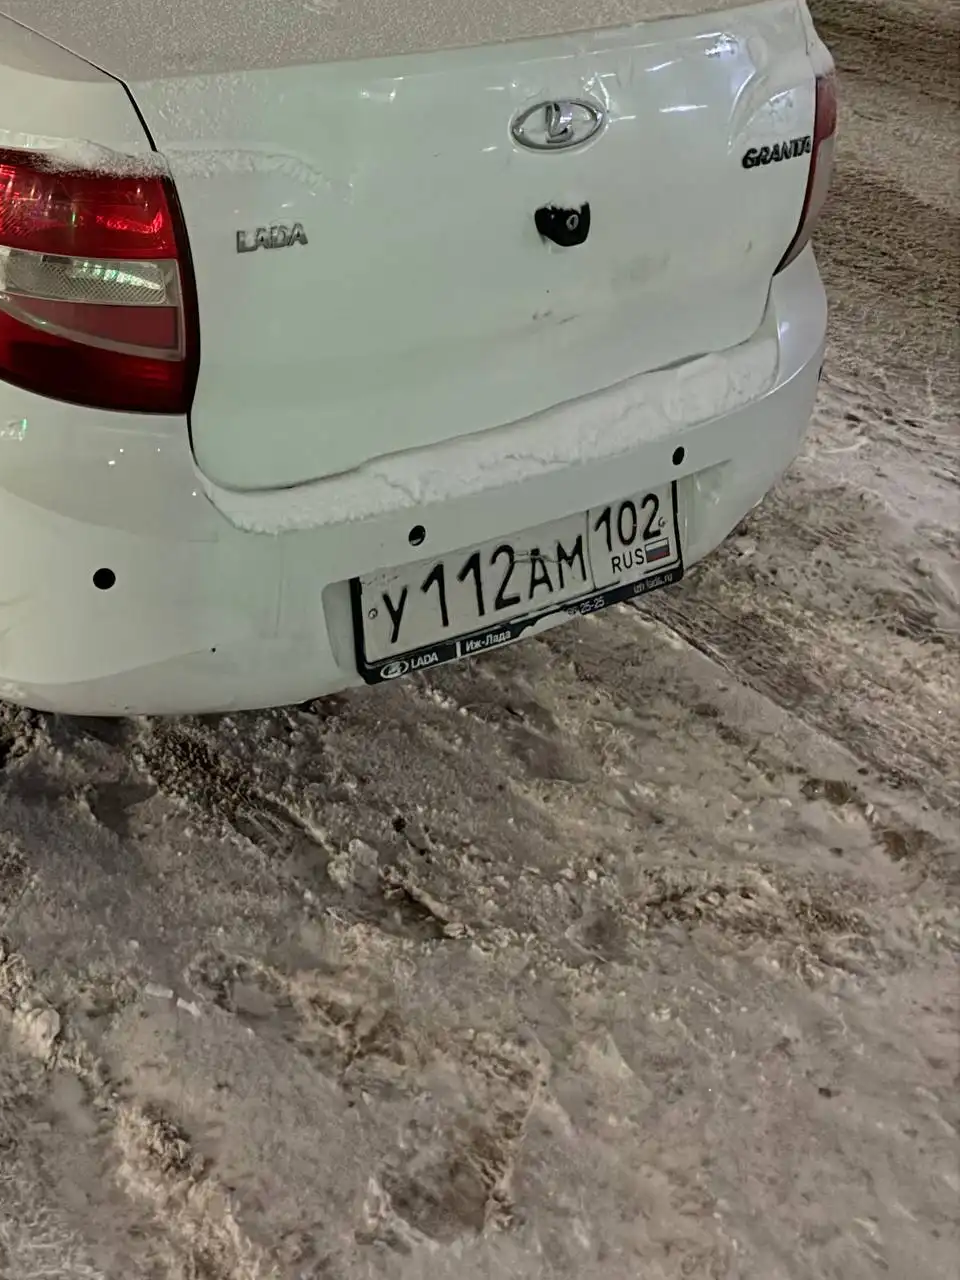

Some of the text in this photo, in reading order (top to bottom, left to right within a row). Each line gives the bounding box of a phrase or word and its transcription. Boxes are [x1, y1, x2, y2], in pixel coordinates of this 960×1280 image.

[741, 135, 812, 170] GRANTA
[236, 222, 309, 254] LADA
[593, 492, 662, 553] 102
[610, 548, 645, 575] RUS
[465, 630, 512, 653] Иж-Лада
[410, 651, 440, 670] LADA
